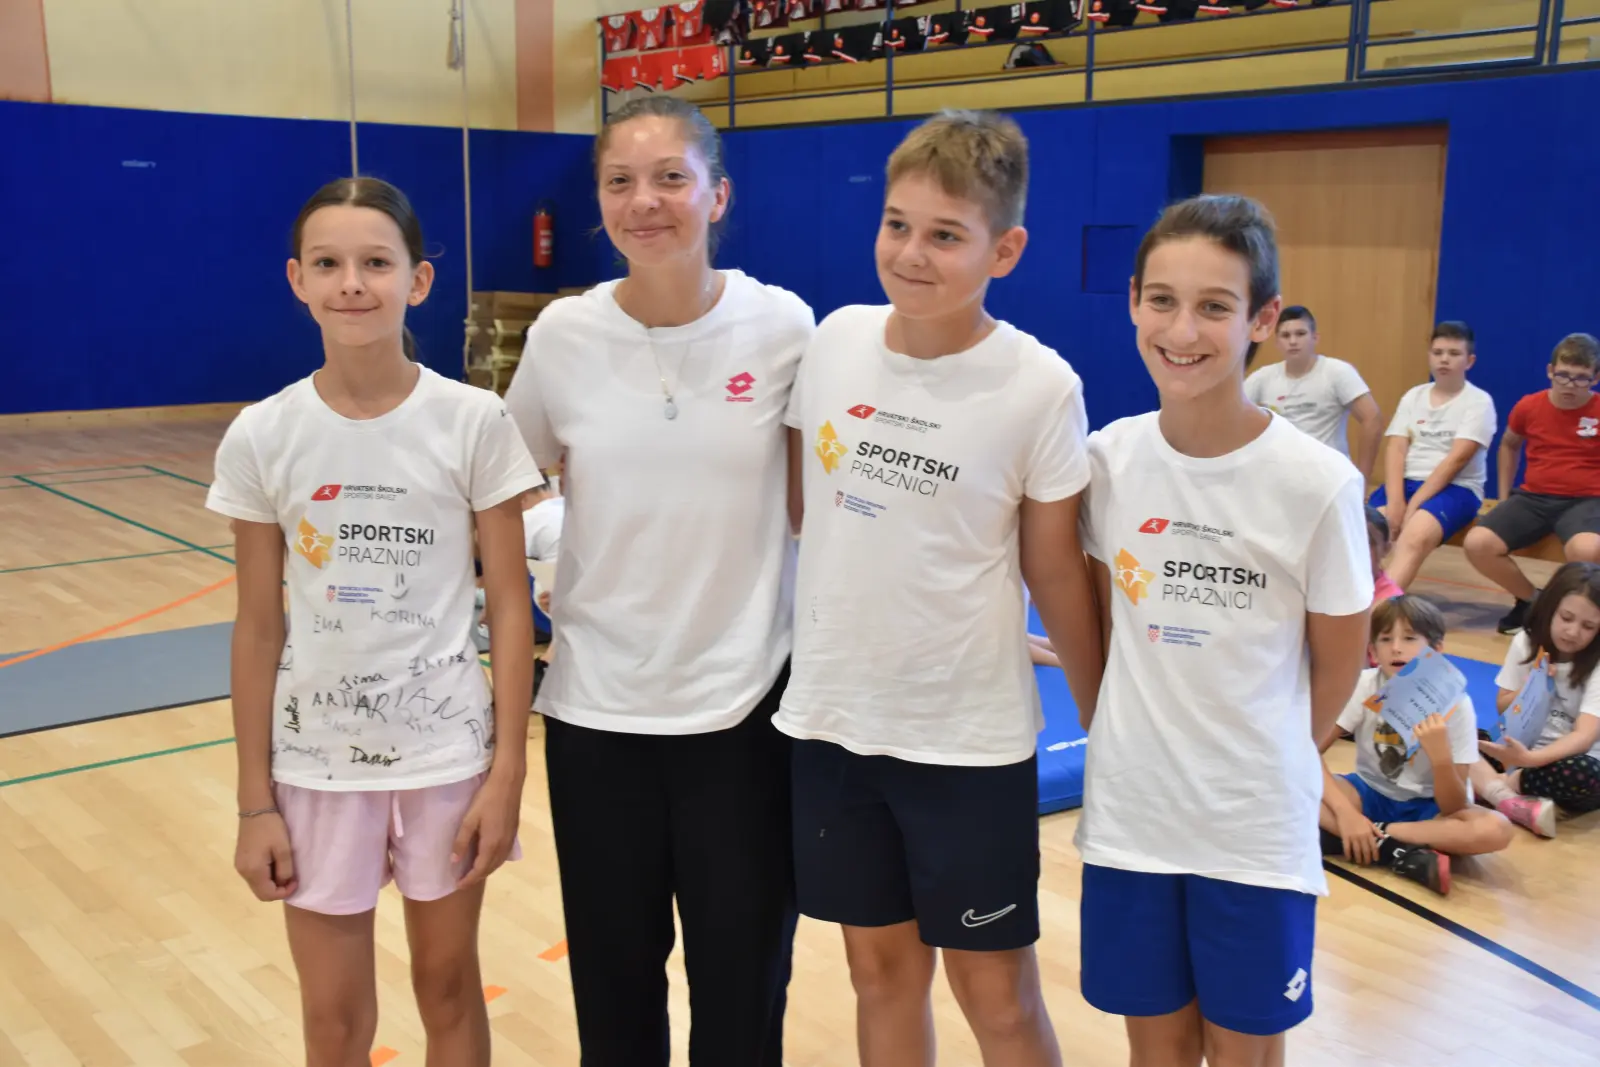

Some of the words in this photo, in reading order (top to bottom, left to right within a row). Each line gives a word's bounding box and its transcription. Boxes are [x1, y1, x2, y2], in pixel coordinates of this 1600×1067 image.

[877, 411, 909, 422] HRVATSKI
[911, 417, 942, 429] ŠKOLSKI
[856, 441, 960, 482] SPORTSKI
[378, 484, 408, 494] ŠKOLSKI
[850, 459, 939, 498] PRAZNICI
[339, 524, 435, 546] SPORTSKI
[338, 546, 422, 567] PRAZNICI
[1163, 560, 1267, 589] SPORTSKI
[1162, 583, 1252, 610] PRAZNICI
[370, 606, 437, 629] KORINA
